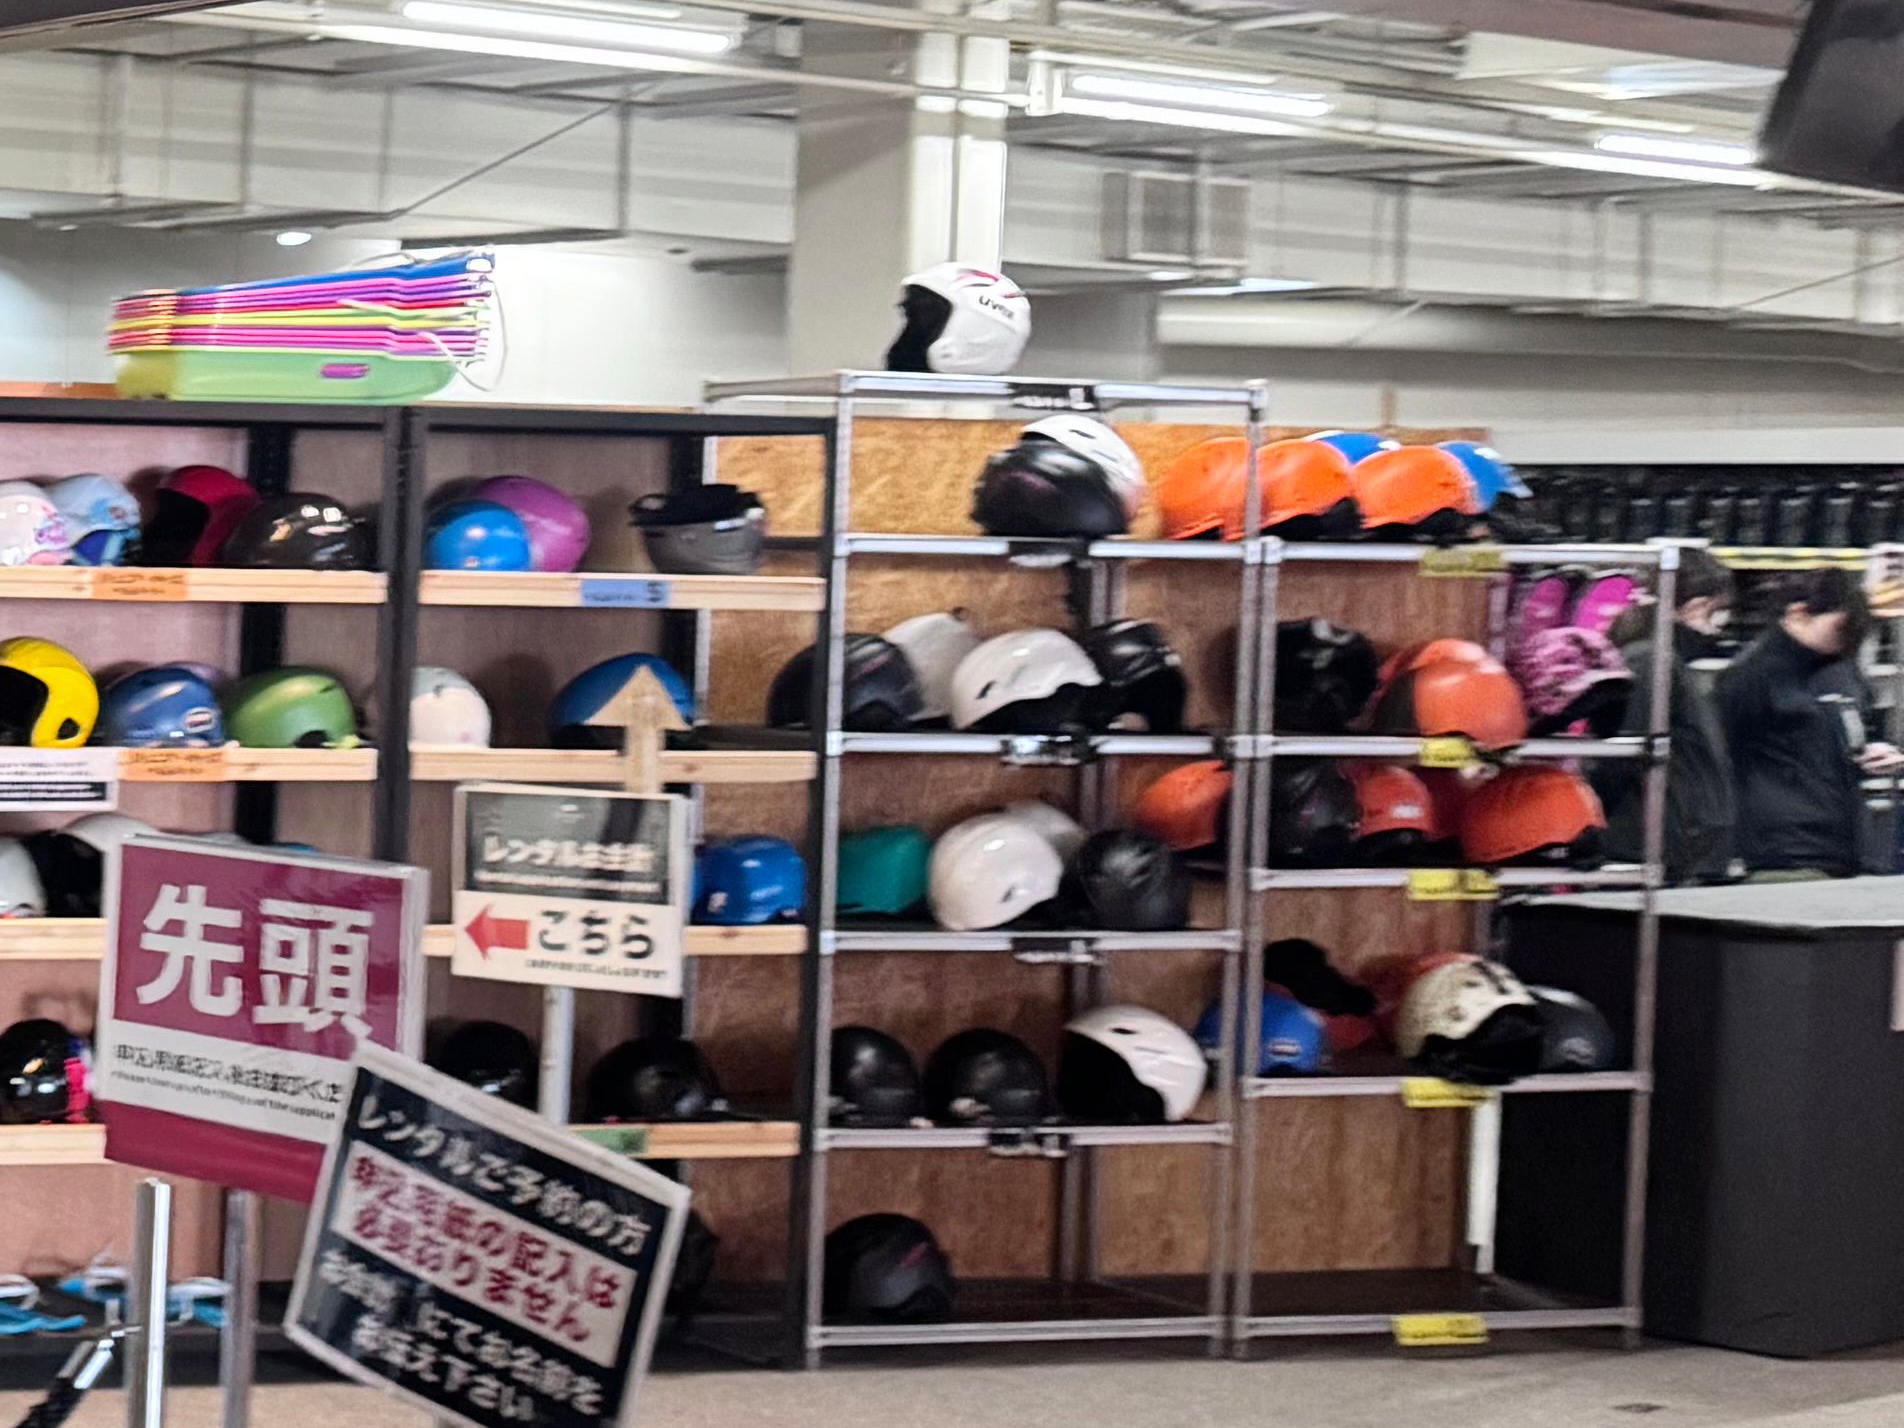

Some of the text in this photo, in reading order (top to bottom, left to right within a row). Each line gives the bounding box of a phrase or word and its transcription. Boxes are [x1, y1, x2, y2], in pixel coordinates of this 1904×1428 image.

[135, 884, 376, 1040] 先頭
[539, 910, 656, 960] こちら
